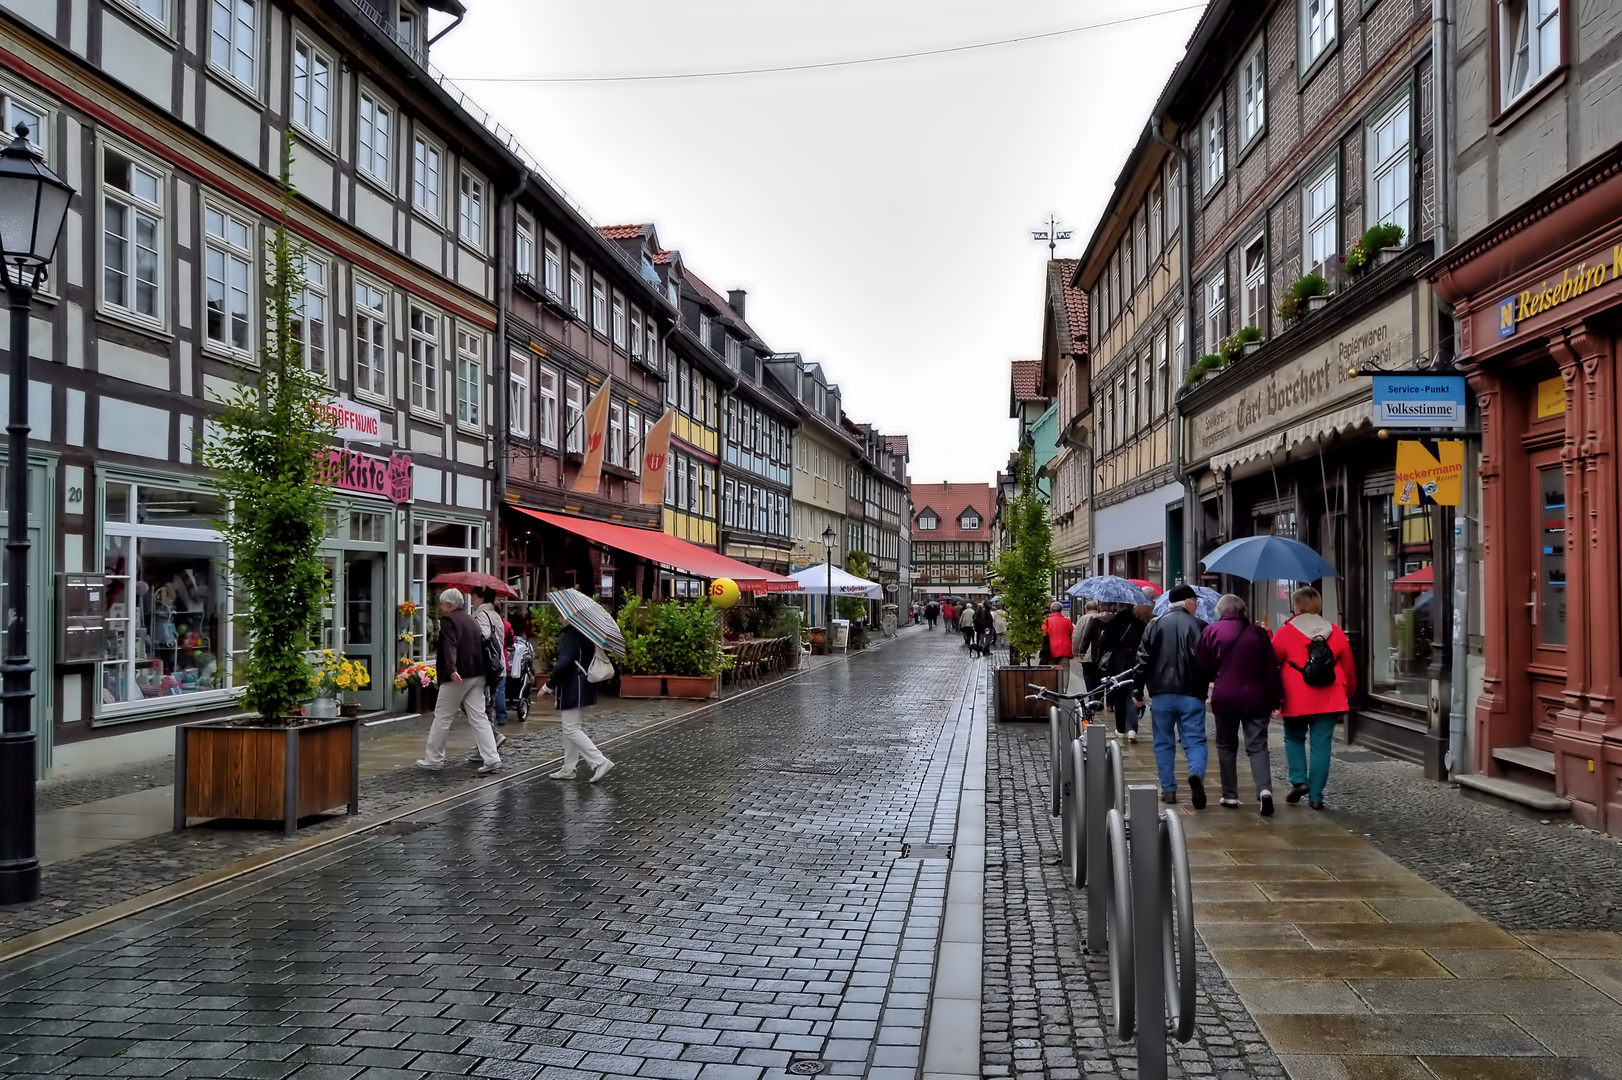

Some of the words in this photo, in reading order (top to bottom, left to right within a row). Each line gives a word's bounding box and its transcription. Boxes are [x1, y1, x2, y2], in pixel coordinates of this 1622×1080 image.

[1517, 262, 1606, 322] Reisebüro
[1338, 324, 1388, 362] Papierwaren
[1236, 391, 1262, 432] Carl
[1266, 357, 1331, 416] Borchert
[1386, 402, 1453, 415] Volksstimme
[1394, 463, 1463, 483] Neckermann
[1436, 473, 1459, 483] Reisen
[68, 487, 83, 504] 20
[709, 584, 724, 597] EIS
